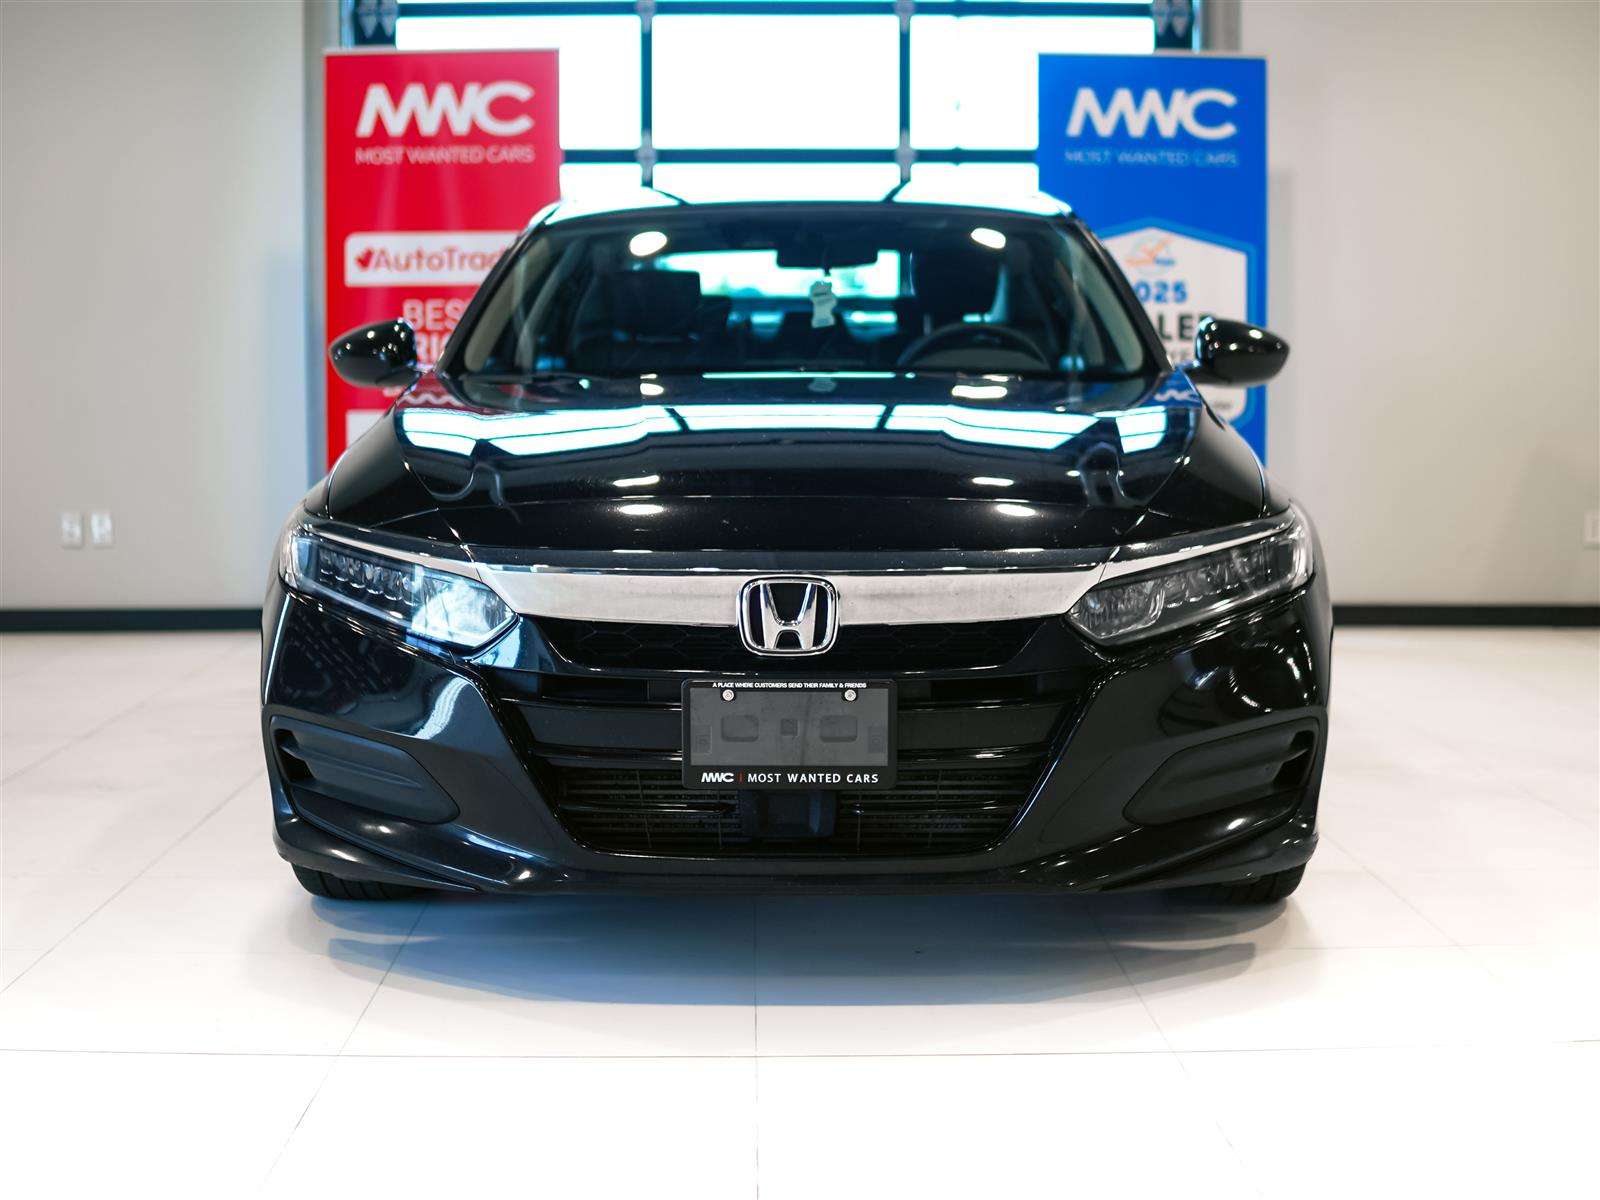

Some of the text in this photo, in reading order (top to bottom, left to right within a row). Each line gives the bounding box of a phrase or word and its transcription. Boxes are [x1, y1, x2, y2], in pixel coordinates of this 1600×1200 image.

[355, 81, 535, 138] MWC
[1066, 87, 1237, 140] MWC
[355, 144, 536, 165] MOST WANTED CARS
[1131, 281, 1188, 304] 025
[403, 299, 472, 331] BES
[701, 772, 879, 783] MWC MOST WANTED CARS
